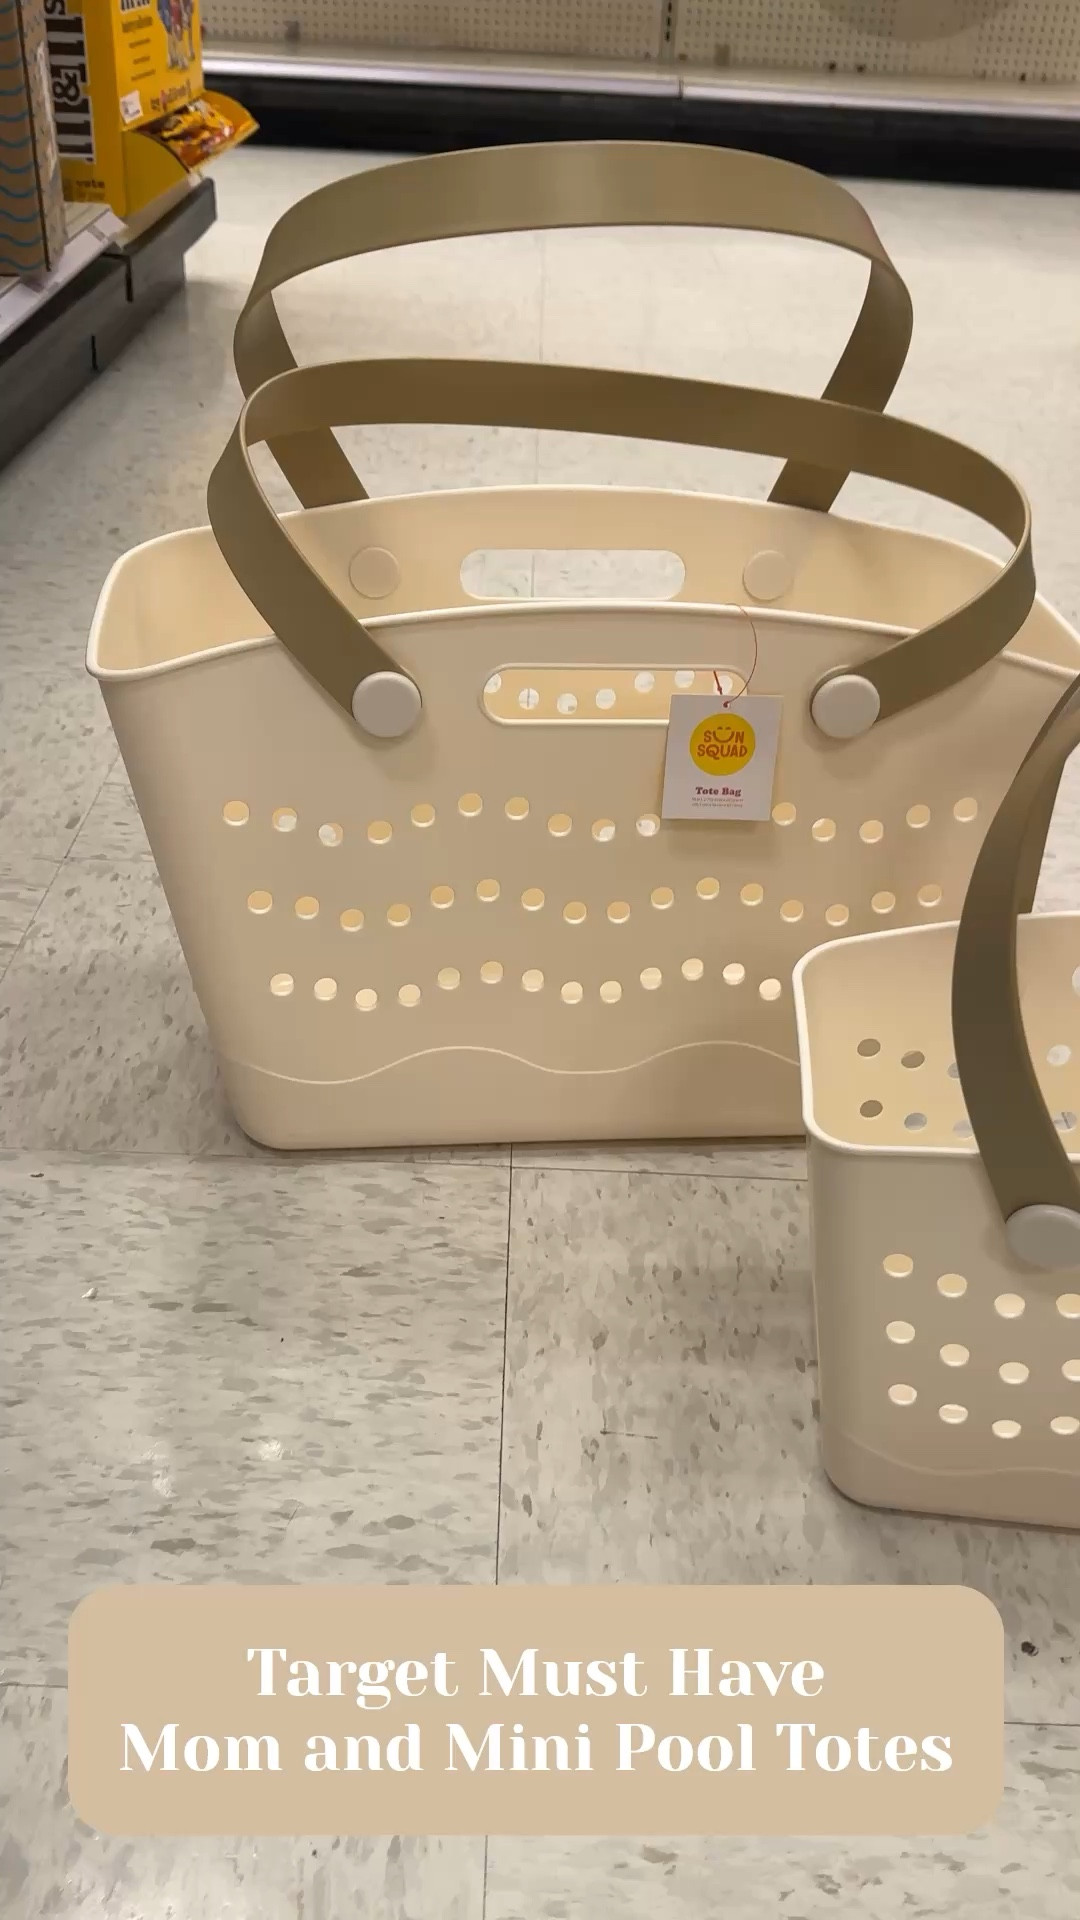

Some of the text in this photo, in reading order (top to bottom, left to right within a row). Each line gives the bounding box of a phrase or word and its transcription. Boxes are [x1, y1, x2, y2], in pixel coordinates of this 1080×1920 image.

[703, 729, 745, 744] SUN
[697, 743, 748, 760] SQUAD
[695, 786, 742, 797] Tote Bag
